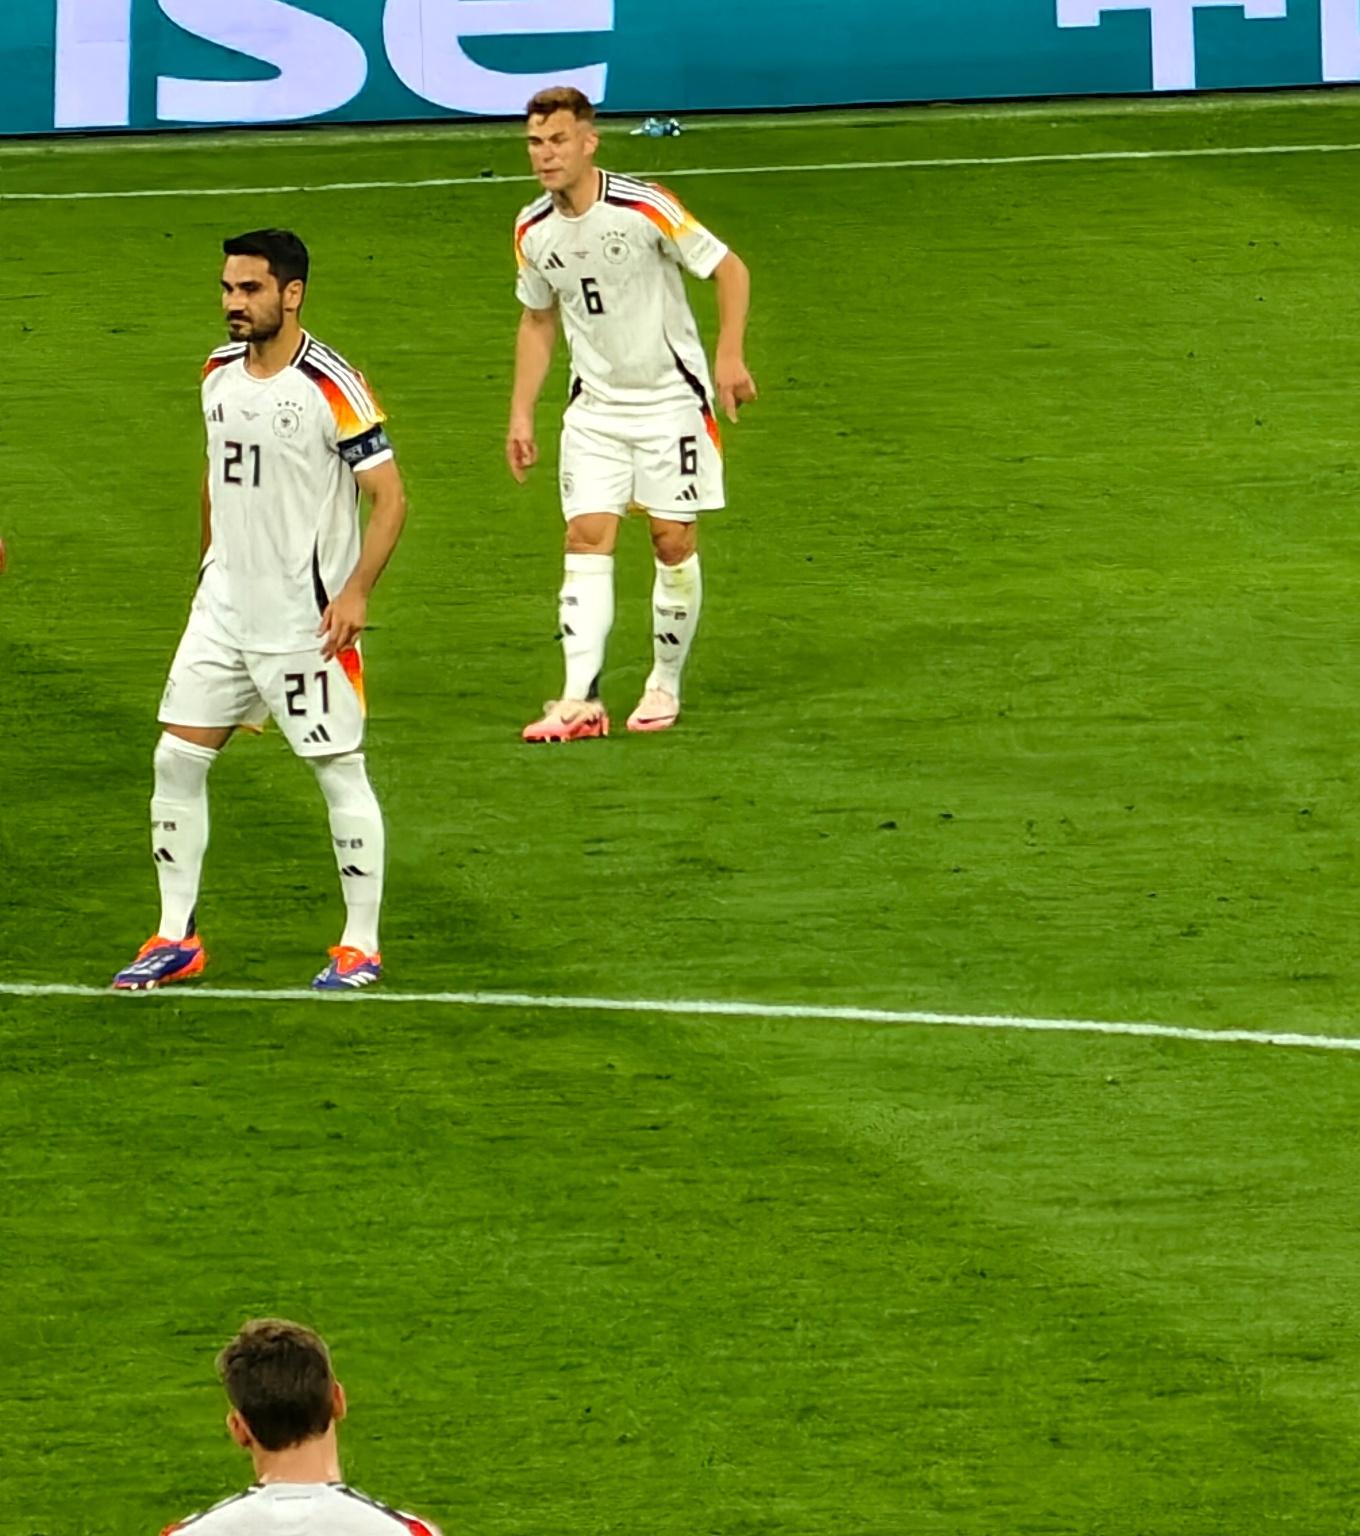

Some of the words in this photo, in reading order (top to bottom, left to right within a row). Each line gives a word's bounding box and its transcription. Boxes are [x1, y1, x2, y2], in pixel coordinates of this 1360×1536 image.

[581, 277, 605, 315] 6
[225, 441, 262, 487] 21
[680, 435, 698, 475] 6
[284, 670, 329, 716] 21
